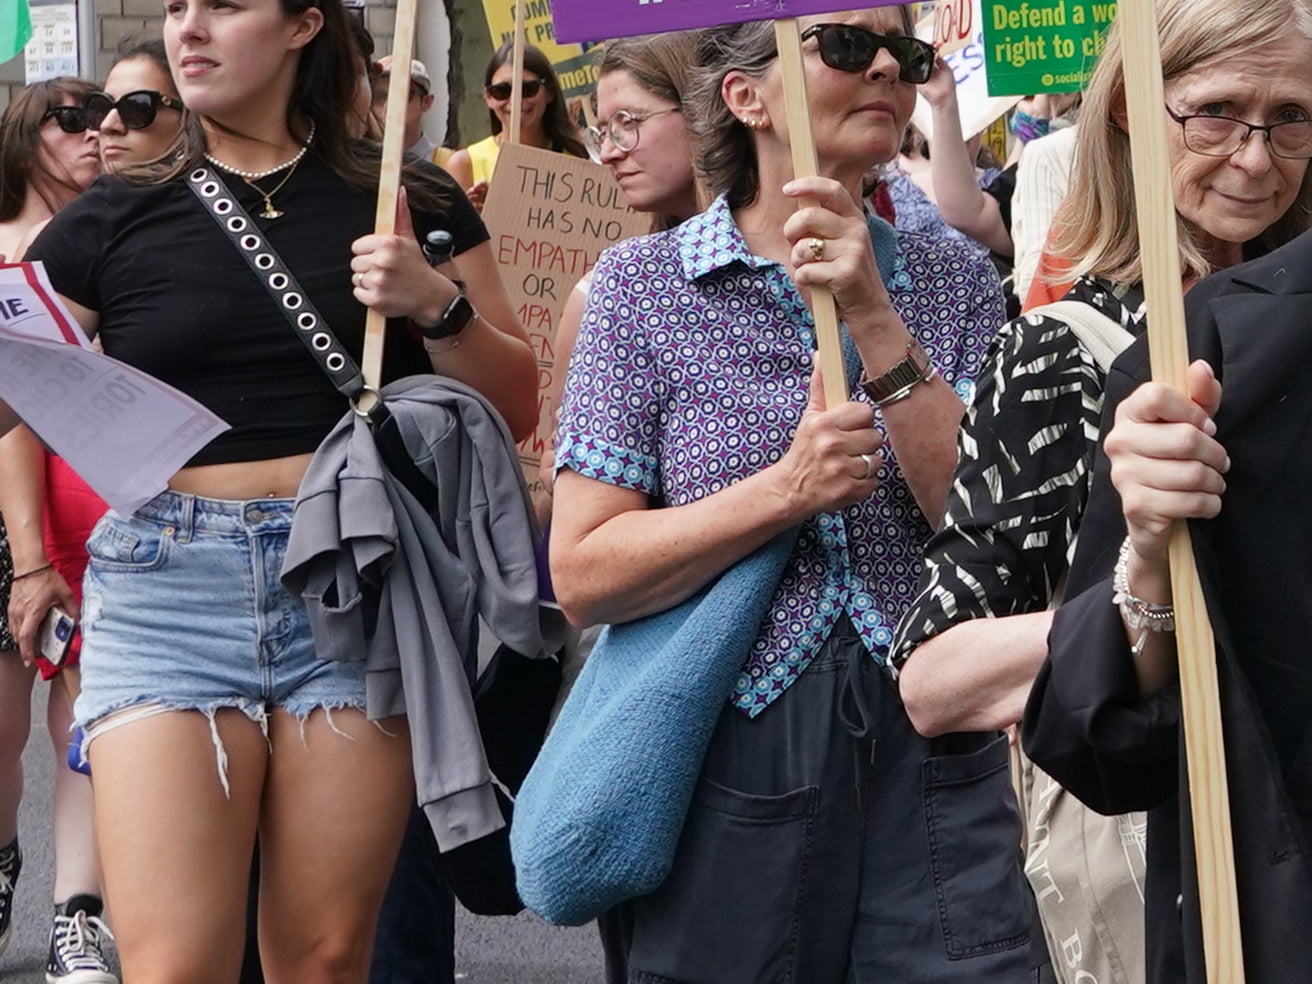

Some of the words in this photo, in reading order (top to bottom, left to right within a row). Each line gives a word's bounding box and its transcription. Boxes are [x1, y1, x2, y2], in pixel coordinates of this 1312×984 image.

[992, 0, 1066, 31] Defend
[1072, 5, 1085, 25] a
[995, 33, 1047, 67] right
[1053, 34, 1076, 58] to
[517, 164, 574, 204] THIS
[581, 176, 634, 213] RUL
[527, 210, 574, 235] HAS
[582, 217, 623, 241] NO
[522, 273, 558, 301] OR
